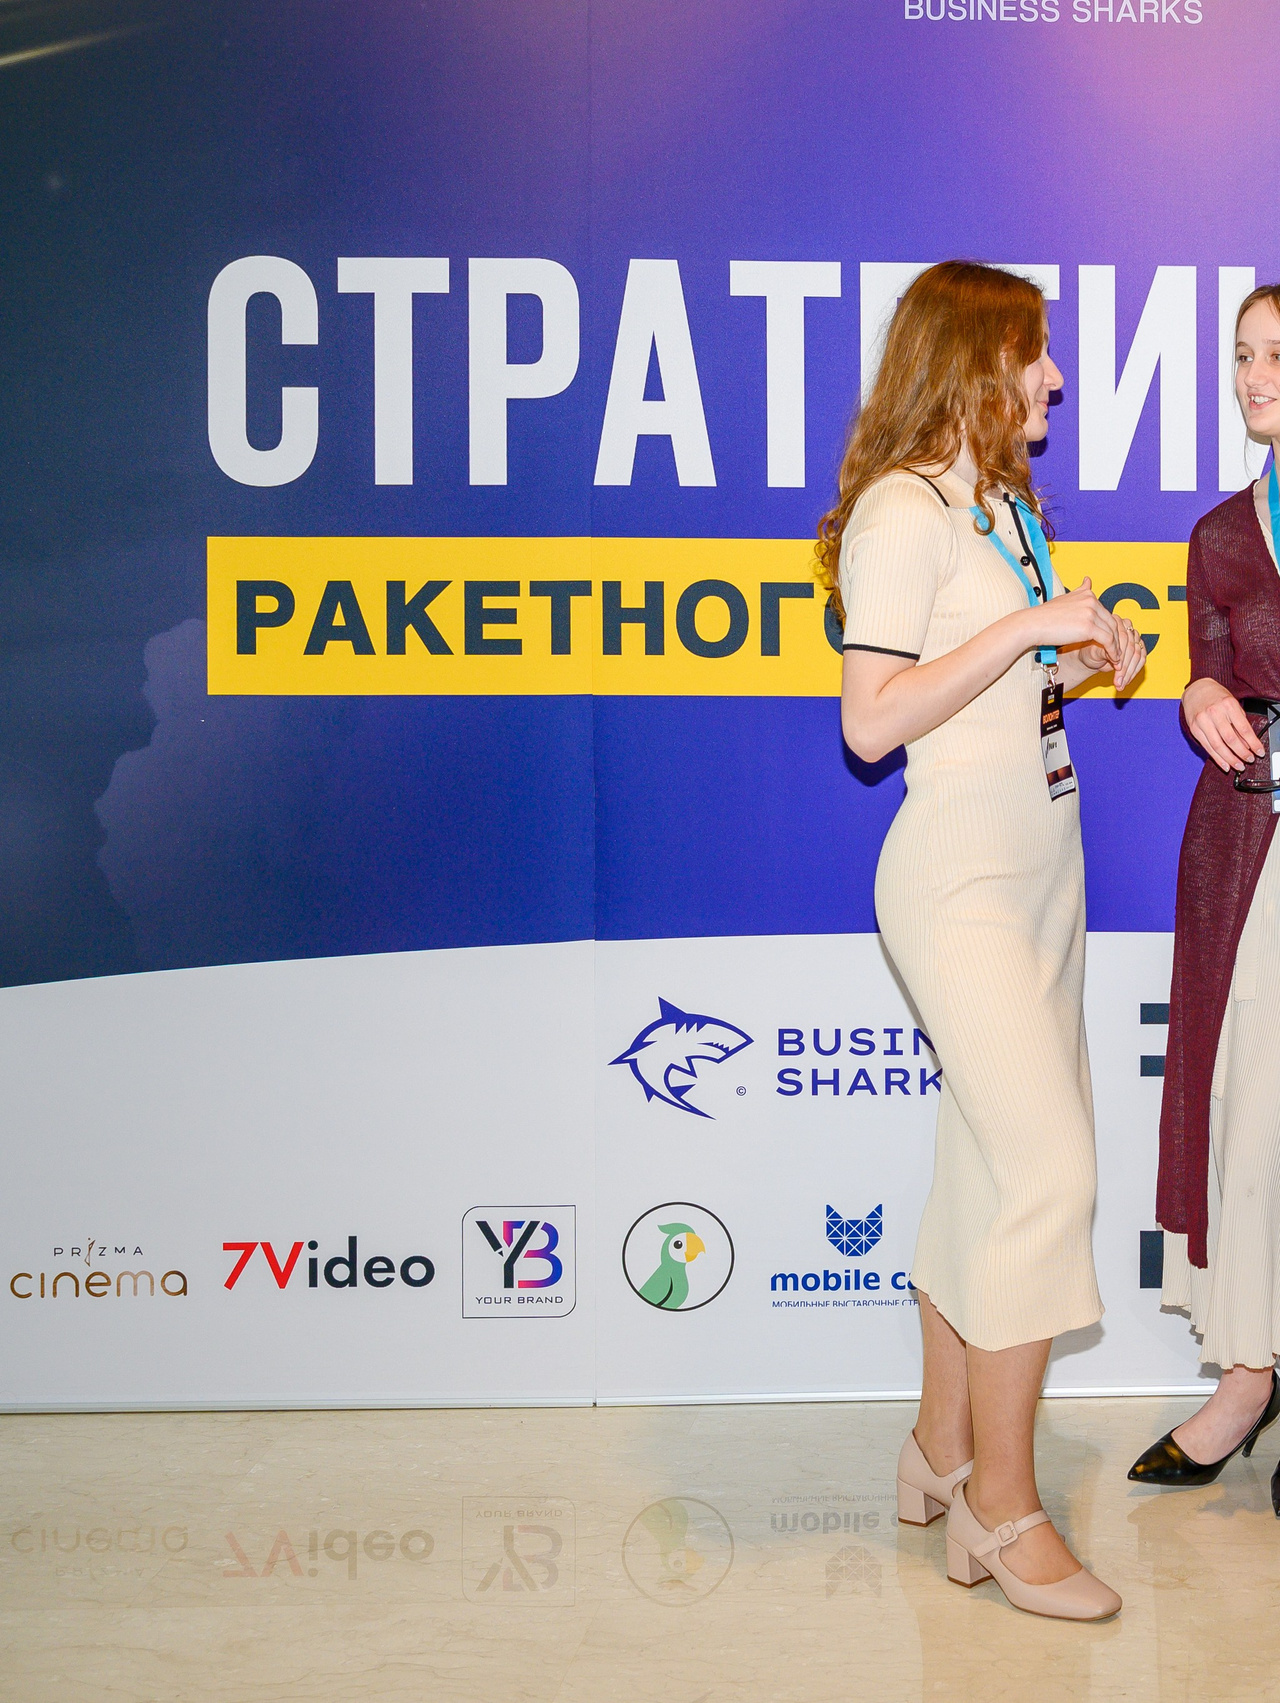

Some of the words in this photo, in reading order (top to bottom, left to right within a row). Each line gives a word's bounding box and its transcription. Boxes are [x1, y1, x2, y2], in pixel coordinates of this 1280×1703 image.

[903, 0, 1061, 22] BUSINESS
[1072, 0, 1204, 24] SHARKS
[235, 578, 845, 658] РАКЕТНОГ
[777, 1027, 938, 1057] BUSIN
[775, 1067, 944, 1097] SHARK
[222, 1235, 436, 1291] 7Video
[9, 1269, 188, 1299] cinema
[770, 1269, 881, 1291] mobile
[475, 1296, 512, 1305] YOUR
[517, 1296, 564, 1304] BRAND
